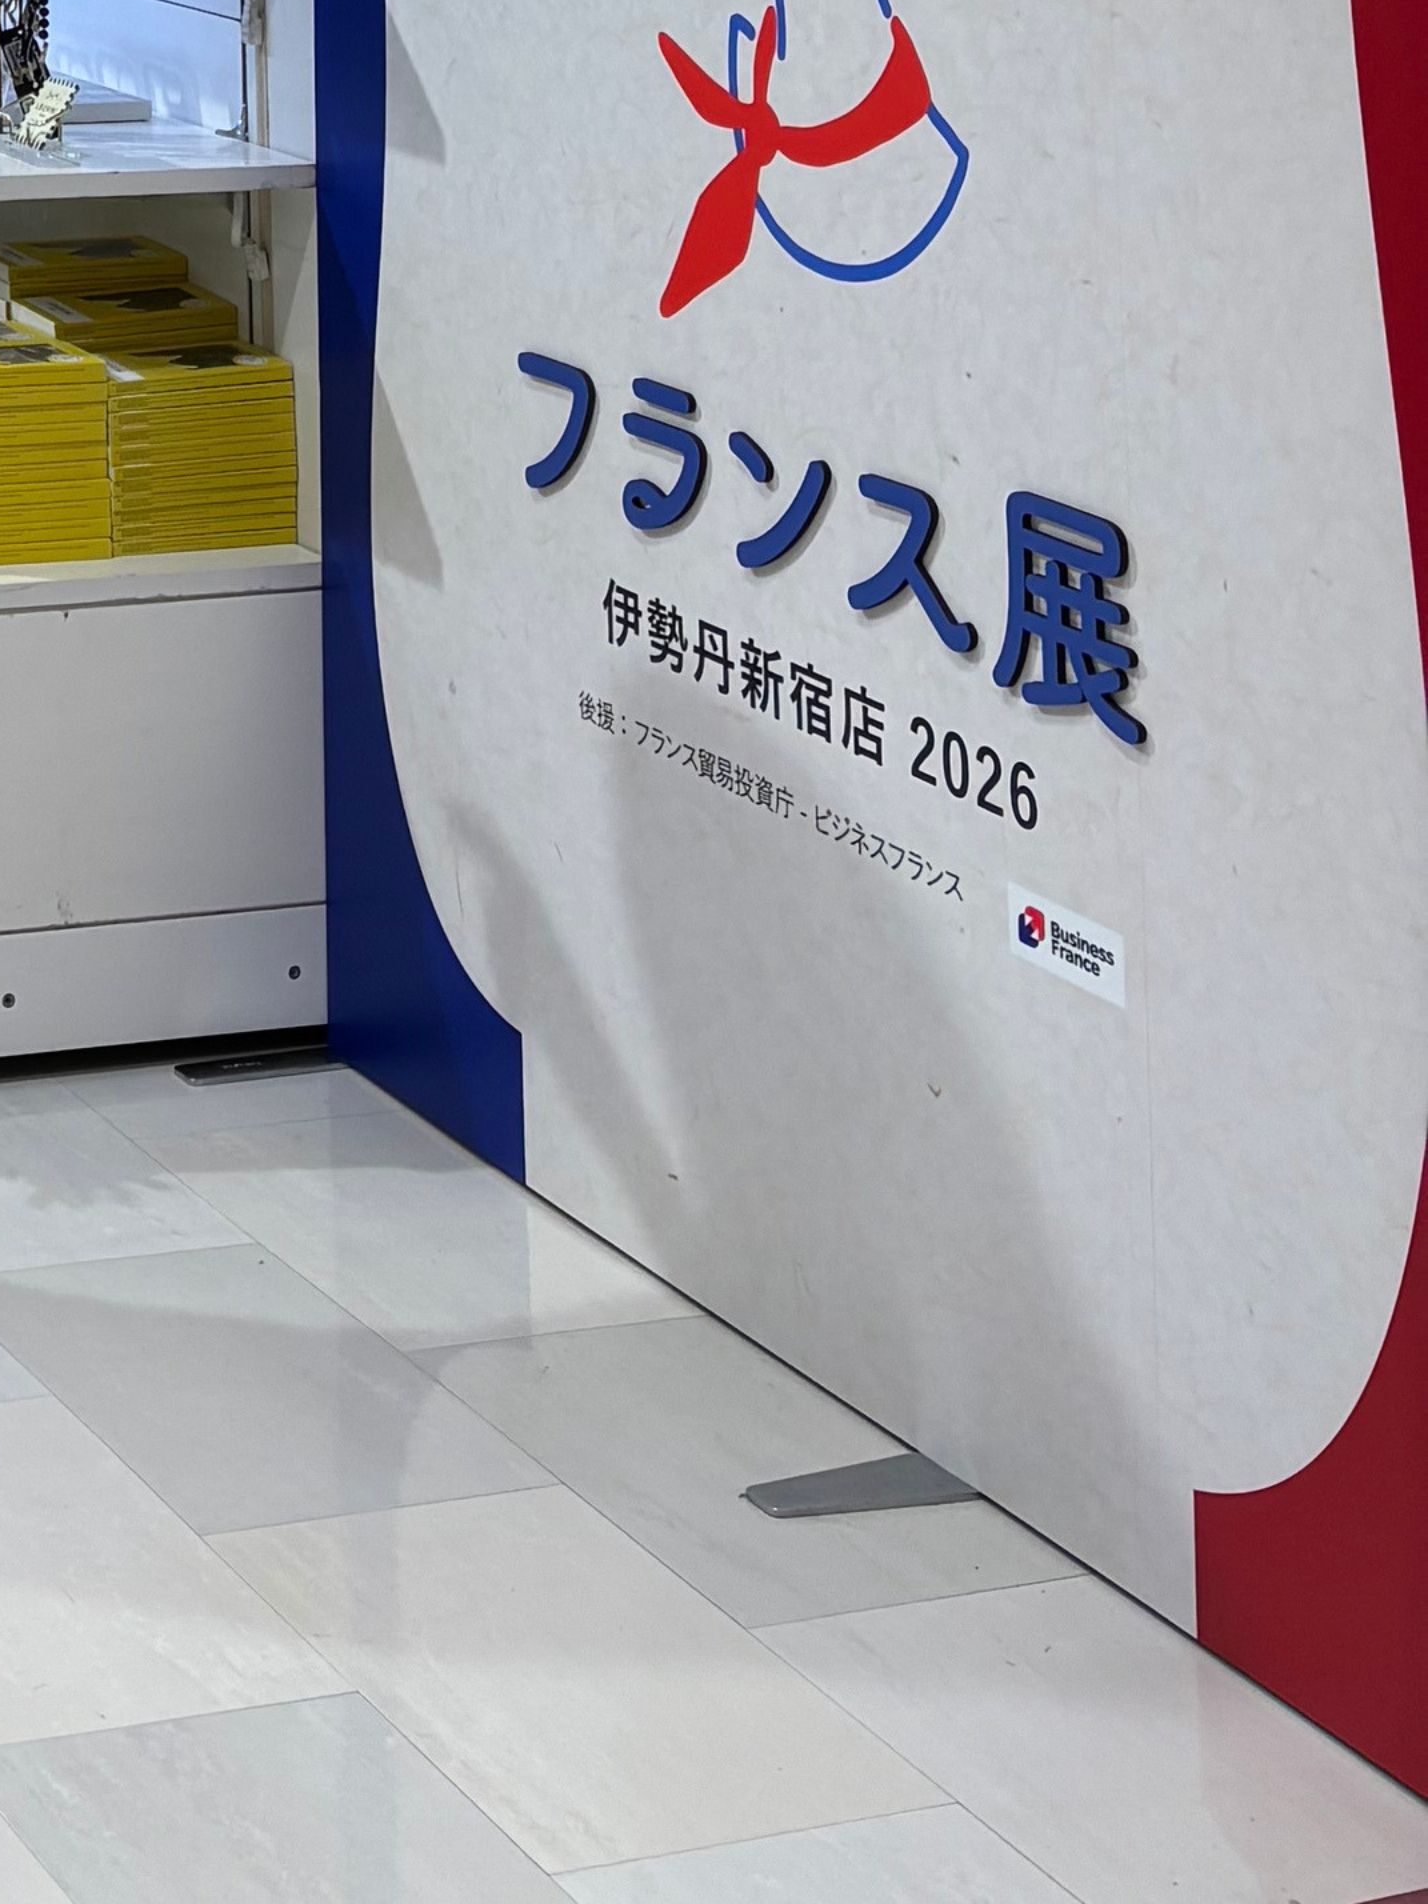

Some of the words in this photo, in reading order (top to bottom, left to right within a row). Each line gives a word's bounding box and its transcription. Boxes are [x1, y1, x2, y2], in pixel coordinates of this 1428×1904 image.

[517, 351, 1149, 755] フランス展
[602, 578, 887, 767] 伊勢丹新宿店
[909, 716, 1039, 831] 2026
[814, 804, 965, 902] ビジネスフランス
[1050, 920, 1115, 966] Business
[1051, 938, 1101, 977] France
